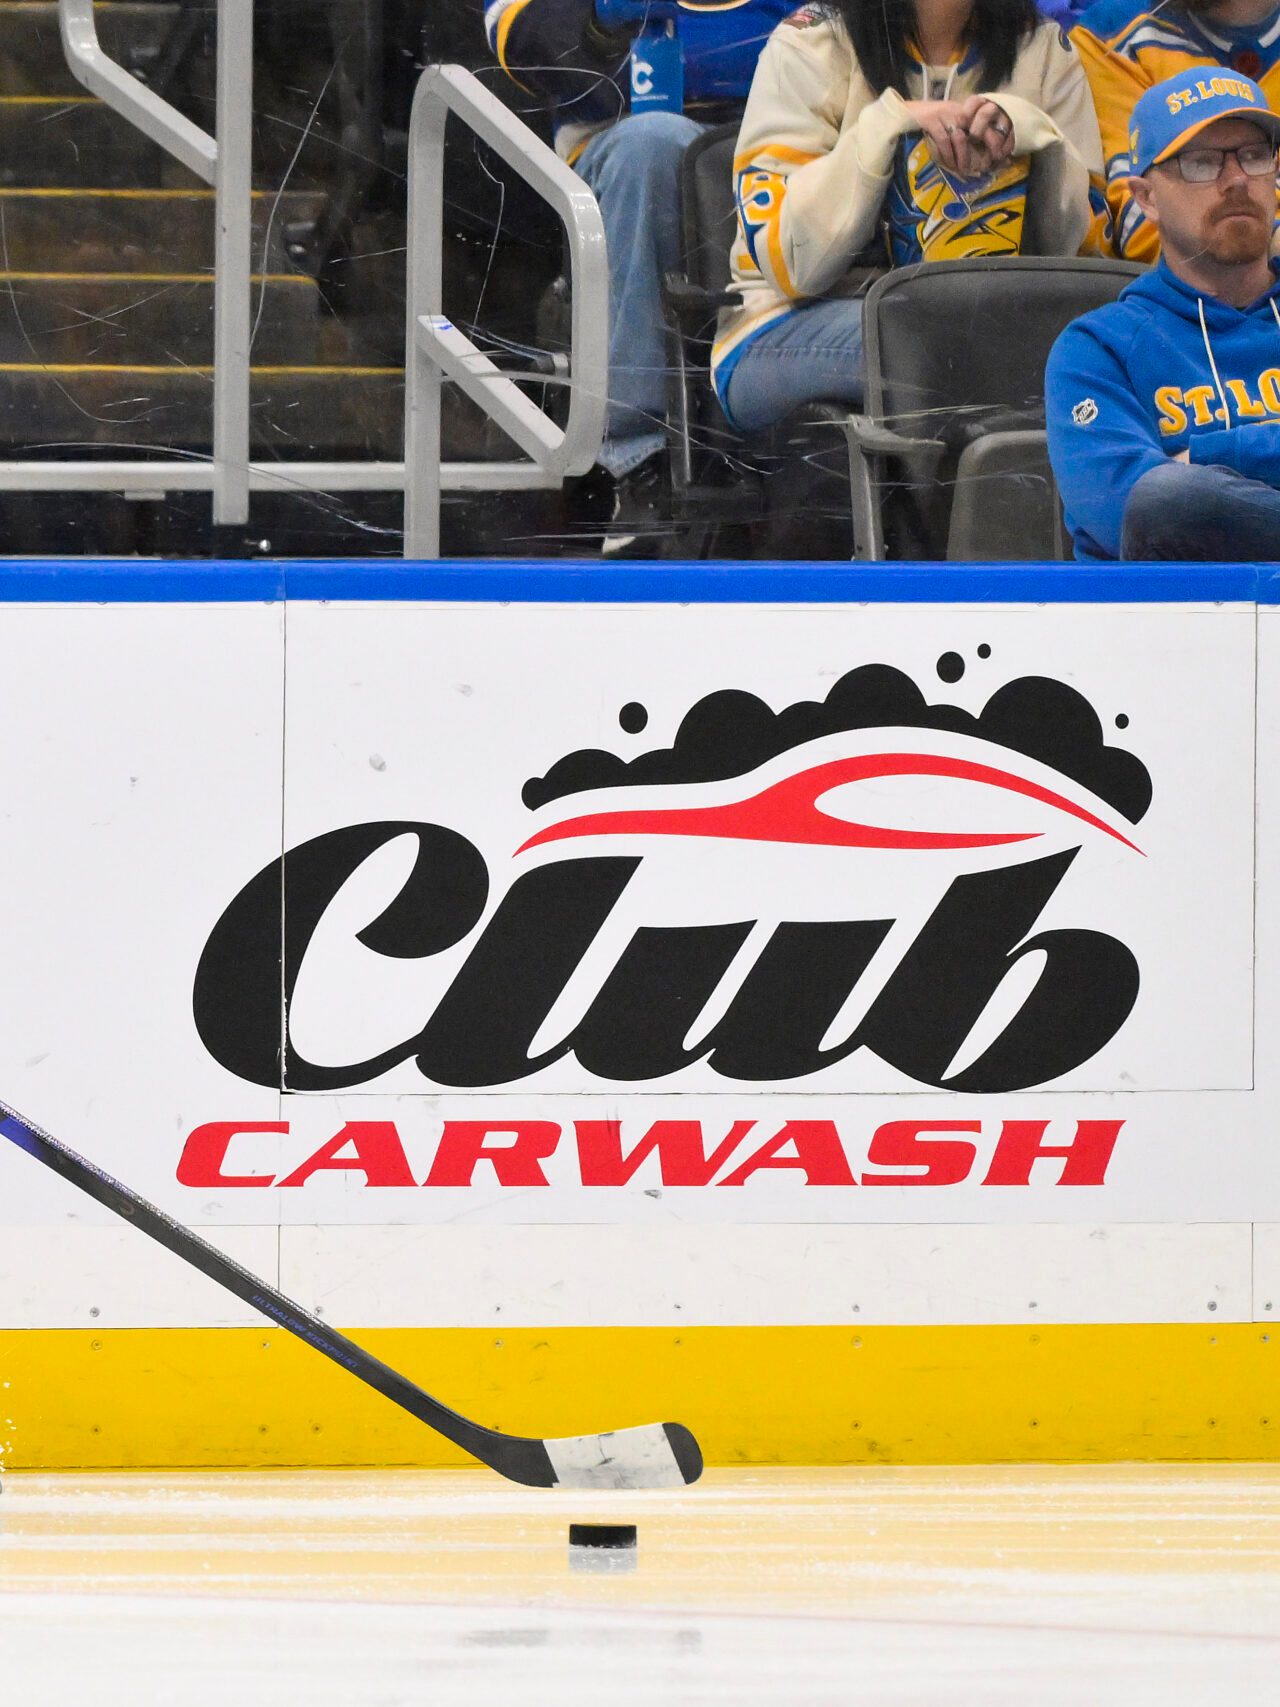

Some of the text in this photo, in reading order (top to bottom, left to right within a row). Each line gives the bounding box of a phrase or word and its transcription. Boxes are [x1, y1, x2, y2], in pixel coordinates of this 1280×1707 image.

[1165, 92, 1199, 115] ST.
[192, 820, 1141, 1094] Club
[175, 1119, 1127, 1188] CARWASH
